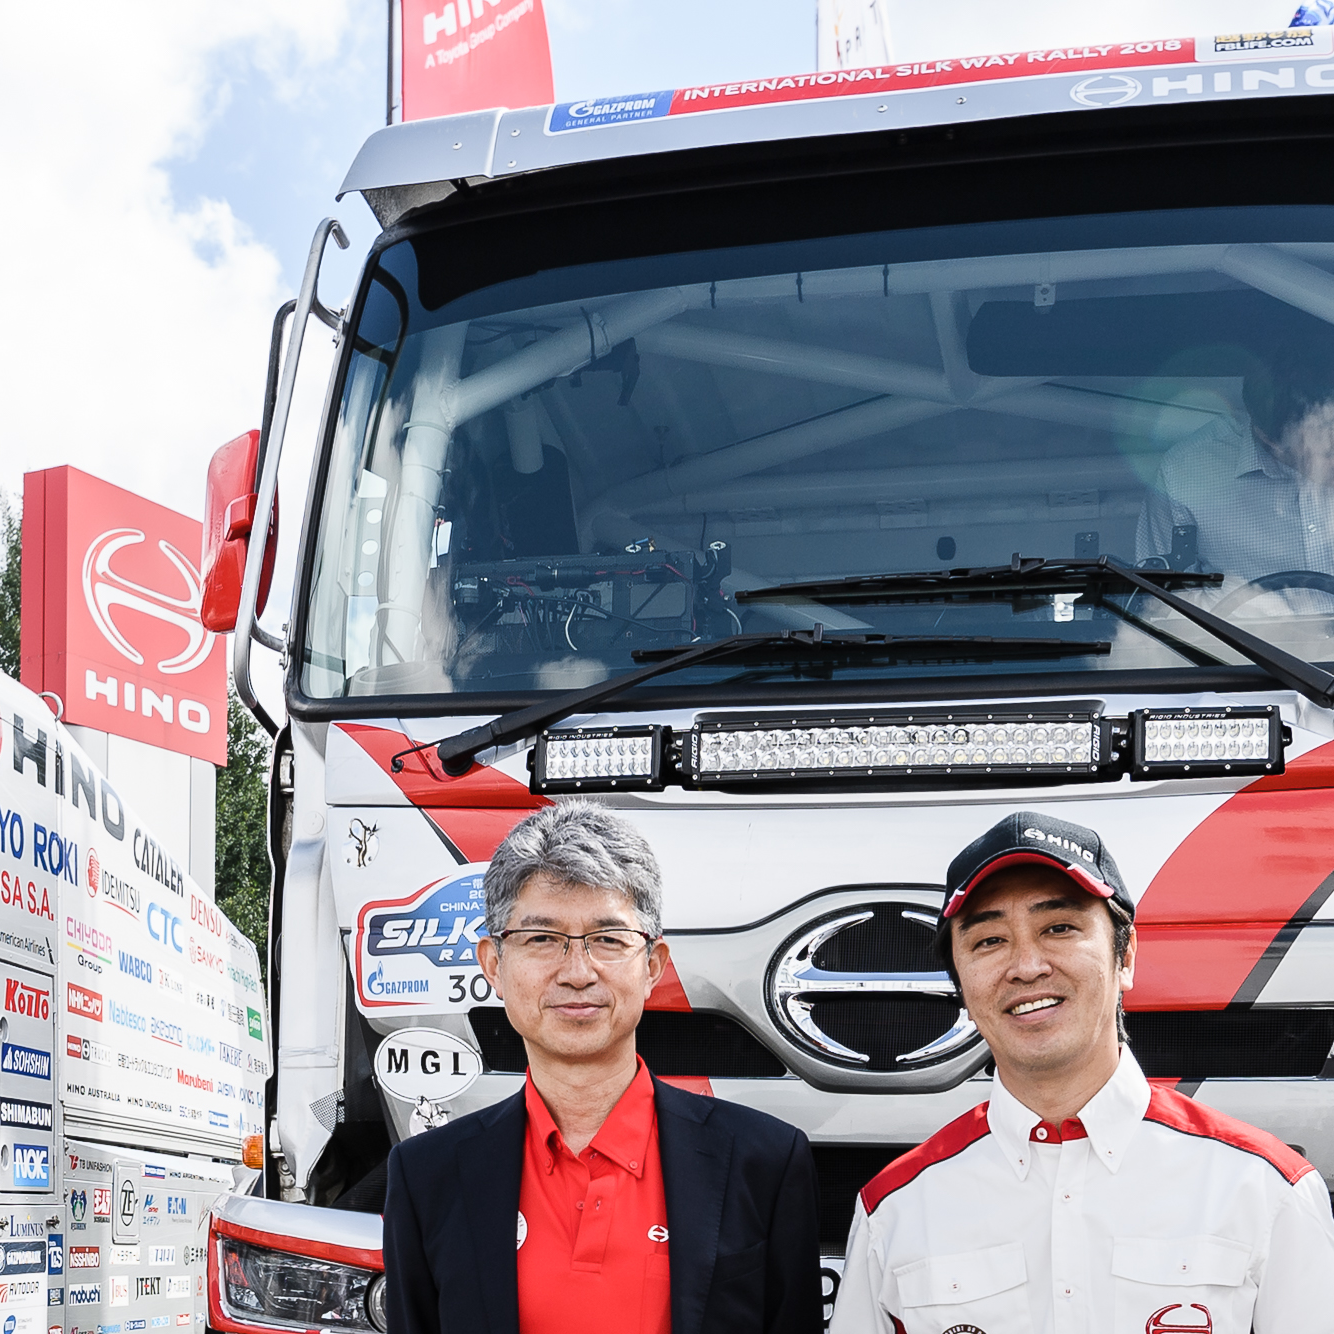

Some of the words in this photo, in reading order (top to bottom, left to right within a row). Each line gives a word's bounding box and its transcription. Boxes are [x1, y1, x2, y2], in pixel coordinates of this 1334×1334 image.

[425, 53, 436, 69] A
[469, 23, 496, 50] Group
[1214, 36, 1313, 53] FBLIFE.COM
[683, 67, 890, 102] INTERNATIONAL
[896, 61, 953, 79] SILK
[960, 53, 1021, 70] WAY
[1026, 45, 1115, 63] RALLY
[1120, 39, 1183, 55] 2018
[566, 115, 607, 128] GENERAL
[611, 110, 653, 123] PARTNER
[593, 97, 656, 117] GAZPROM
[85, 668, 211, 735] HINO
[1173, 712, 1227, 720] INDUSTRIES
[569, 732, 614, 740] INDUSTRIES
[690, 734, 699, 769] RIGID
[1092, 724, 1101, 762] RIGID
[12, 713, 125, 842] HINO
[33, 822, 78, 888] ROKI
[133, 827, 184, 898] CATALER
[1047, 833, 1094, 863] HINO
[27, 881, 55, 921] S.A.
[101, 868, 141, 914] IDEMITSU
[147, 902, 183, 953] CTC
[190, 894, 222, 937] DENSO
[24, 938, 46, 957] Airlines
[67, 916, 112, 955] CHIYODA
[376, 916, 486, 949] SILK
[77, 953, 103, 975] Group
[118, 949, 152, 984] WABCO
[197, 945, 225, 975] SANKYO
[385, 979, 429, 995] GAZPROM
[108, 999, 147, 1033] Nabtesco
[13, 1050, 49, 1076] SOHSHIN
[219, 1041, 243, 1069] TAKEBE
[67, 1083, 85, 1096] HINO
[88, 1087, 121, 1103] AUSTRALIA
[177, 1068, 214, 1093] Marubeni
[0, 1102, 52, 1128] SHIMABUN
[127, 1096, 143, 1108] HINO
[145, 1100, 172, 1113] INDONESIA
[15, 1148, 48, 1180] NOK
[135, 1277, 161, 1301] JTEKT
